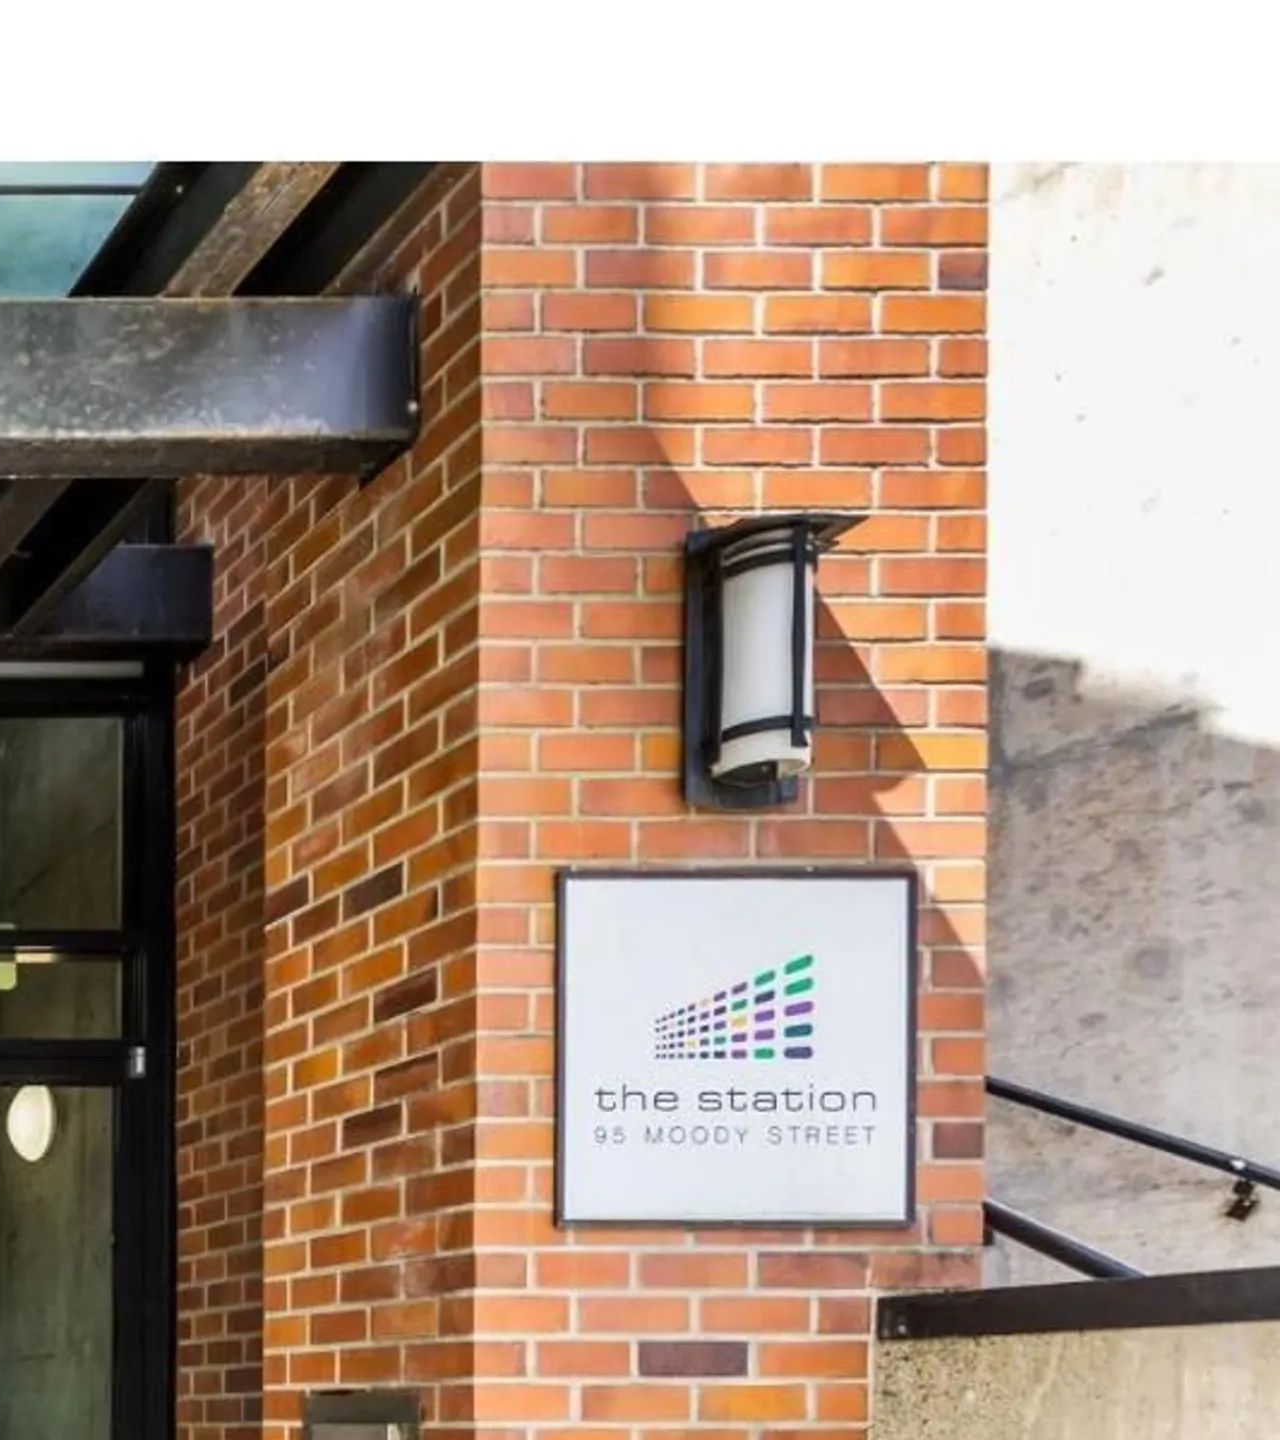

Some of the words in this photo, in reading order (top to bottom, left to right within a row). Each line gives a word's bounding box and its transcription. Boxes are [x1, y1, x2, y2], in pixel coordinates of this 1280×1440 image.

[593, 1084, 679, 1113] the
[697, 1084, 877, 1113] station
[593, 1125, 627, 1146] 95
[643, 1125, 750, 1146] MOODY
[766, 1125, 877, 1146] STREET
